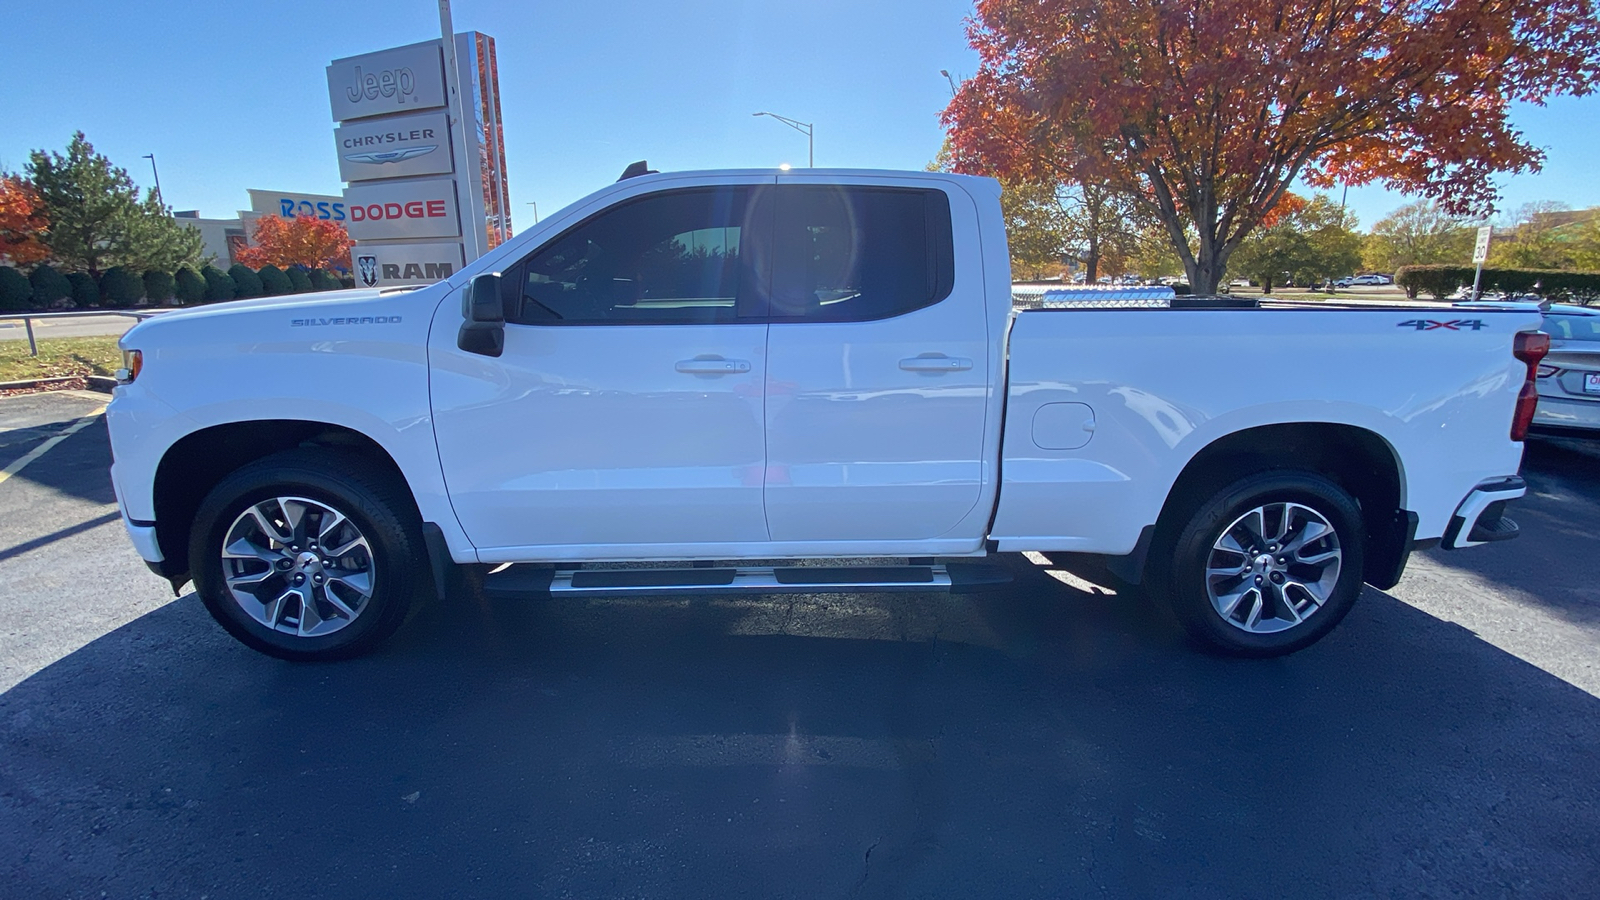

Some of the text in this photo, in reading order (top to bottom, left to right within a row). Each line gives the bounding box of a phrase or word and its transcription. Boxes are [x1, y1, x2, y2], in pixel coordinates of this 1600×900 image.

[346, 65, 414, 104] Jeep
[343, 129, 435, 148] CHRYSLER
[279, 198, 346, 221] ROSS
[350, 200, 447, 222] DODGE
[1475, 245, 1486, 259] 30
[381, 262, 453, 280] RAM
[290, 315, 402, 328] SILVERADO
